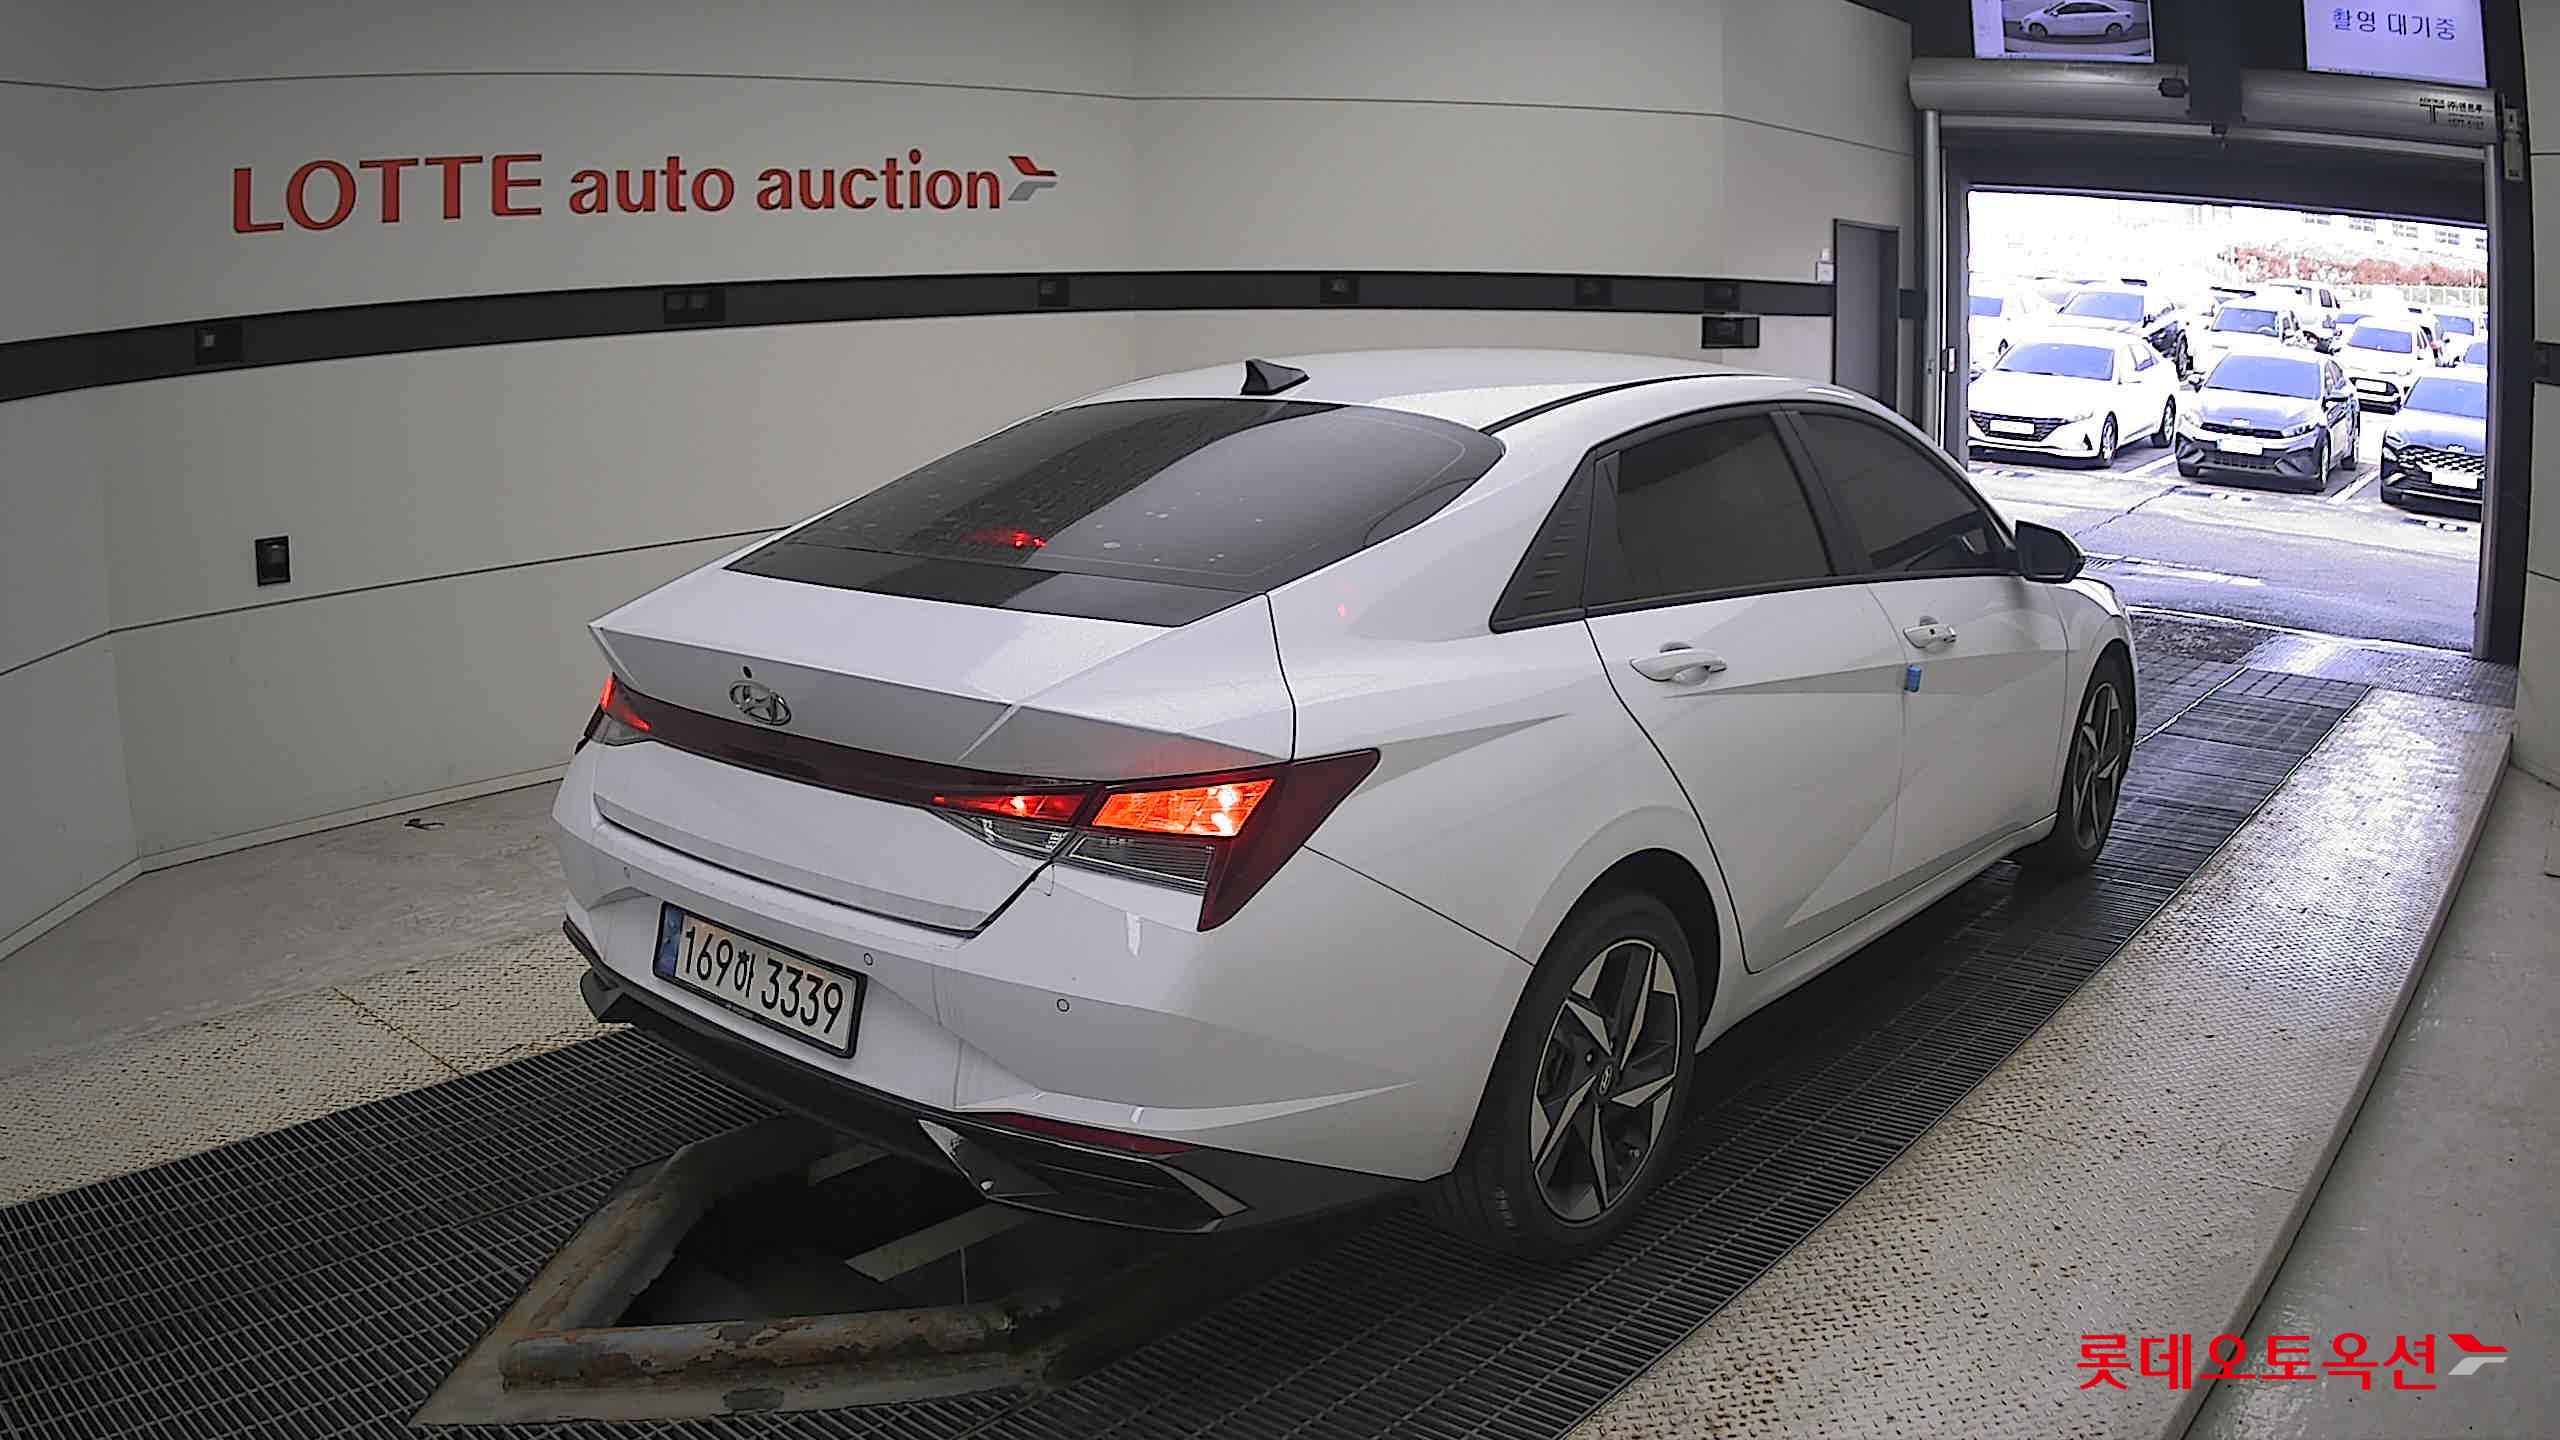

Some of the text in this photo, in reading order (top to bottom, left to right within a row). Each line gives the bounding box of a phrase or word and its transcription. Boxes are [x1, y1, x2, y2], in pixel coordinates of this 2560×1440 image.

[2332, 7, 2456, 41] 촬영 대기중
[233, 149, 1001, 232] LOTTE auto auction
[760, 957, 844, 1034] 3339
